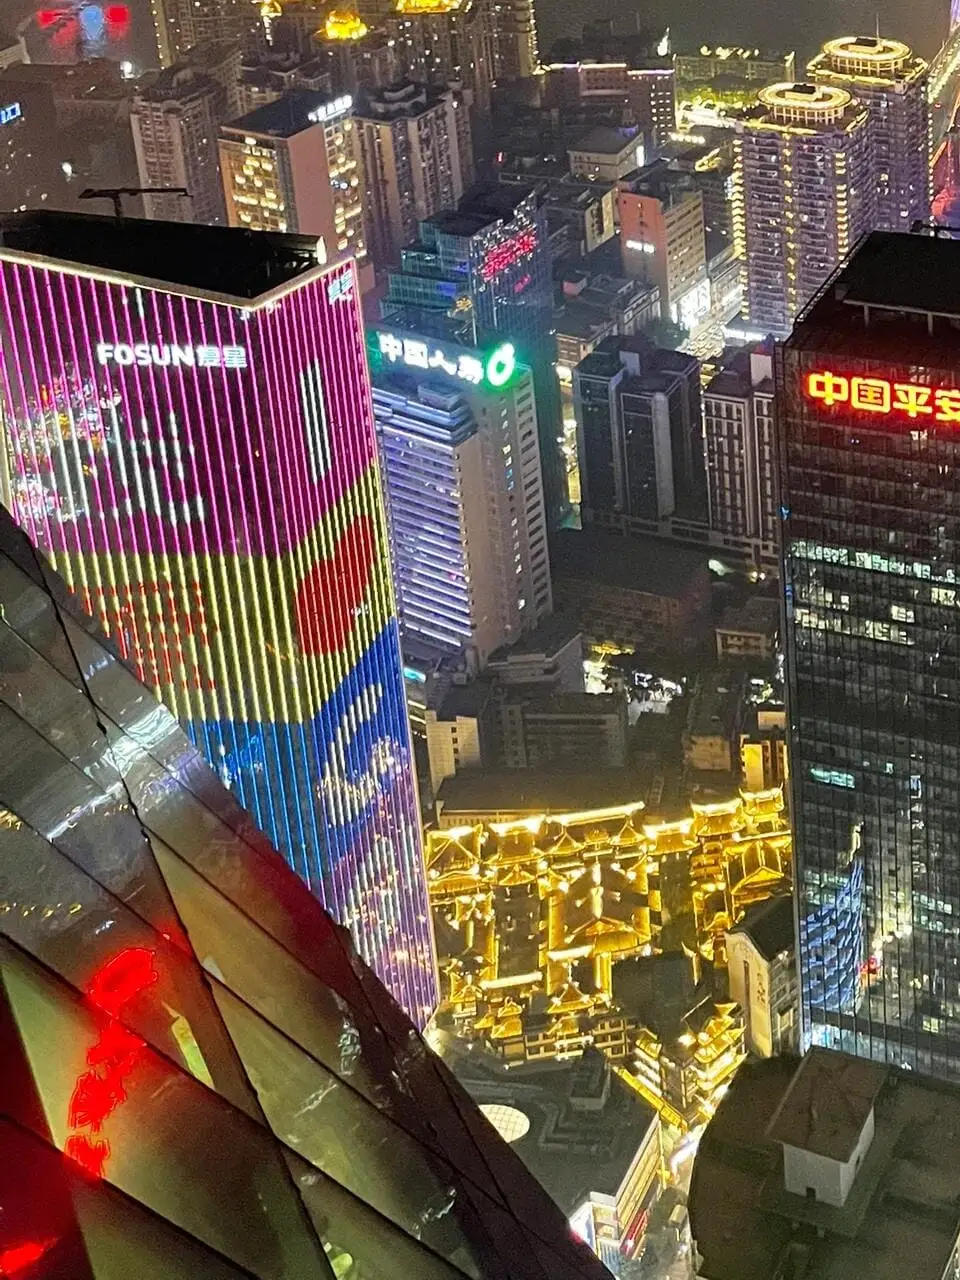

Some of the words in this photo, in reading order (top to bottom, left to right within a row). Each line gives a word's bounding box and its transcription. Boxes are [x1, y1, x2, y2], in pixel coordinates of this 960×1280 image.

[96, 343, 194, 367] FOSUN
[377, 331, 484, 385] 中国人寿
